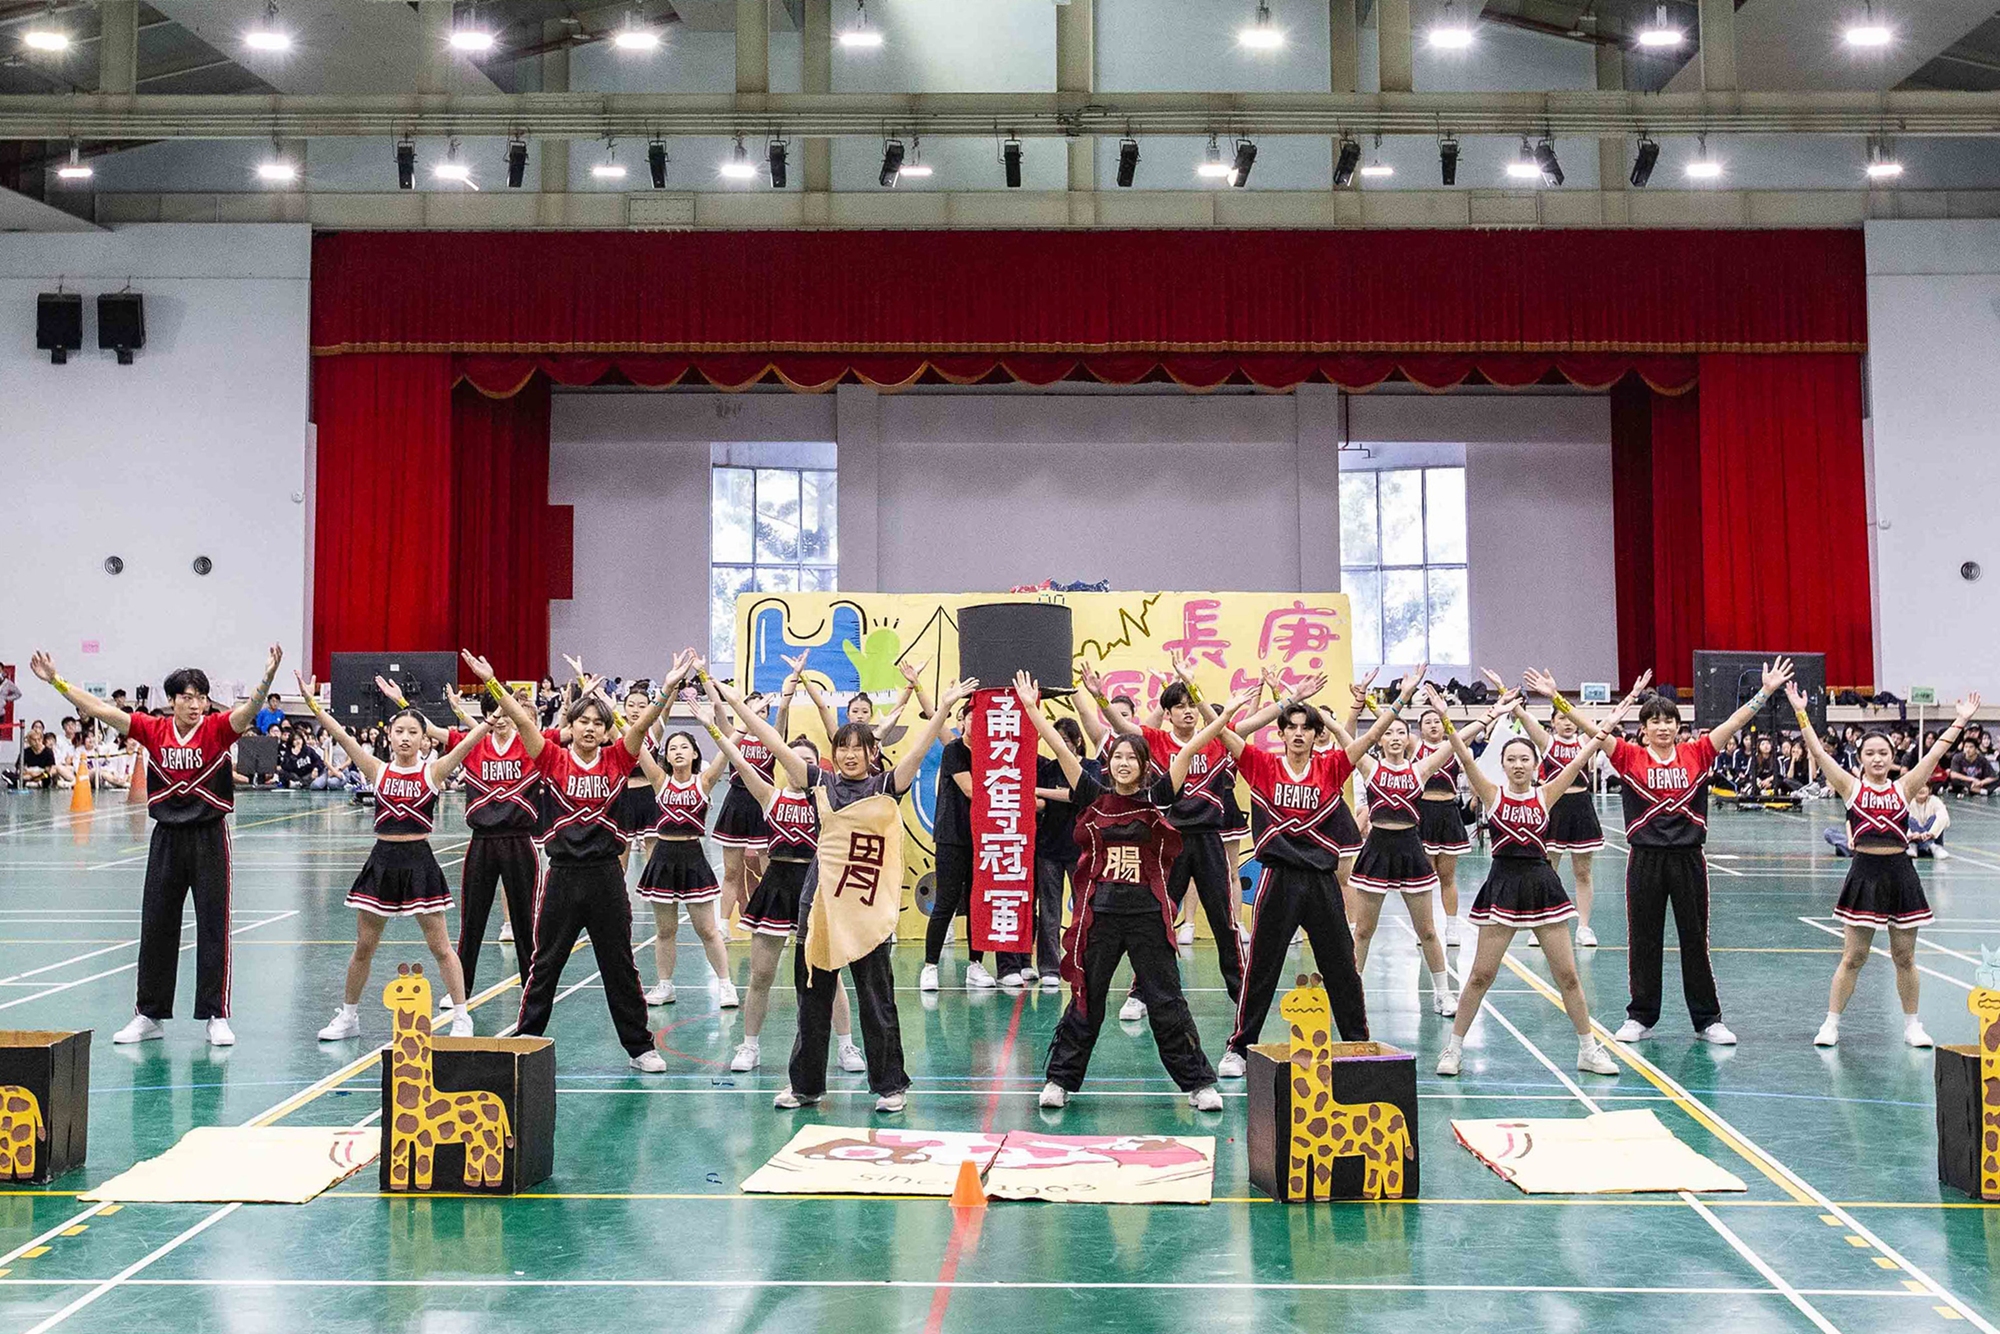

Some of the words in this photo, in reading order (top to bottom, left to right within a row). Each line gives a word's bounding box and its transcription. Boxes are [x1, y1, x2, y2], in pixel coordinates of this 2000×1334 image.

[160, 747, 203, 770] BEARS
[740, 744, 768, 759] BEARS
[481, 760, 522, 781] BEARS
[1379, 771, 1415, 790] BEARS
[1647, 767, 1689, 789] BEARS
[382, 778, 421, 798] BEARS
[566, 775, 610, 798] BEARS
[662, 788, 697, 806] BEARS
[1274, 783, 1320, 810] BEARS
[1861, 791, 1901, 811] BEARS
[775, 803, 815, 824] BEARS
[1501, 803, 1542, 825] BEARS
[1102, 845, 1142, 884] 腸
